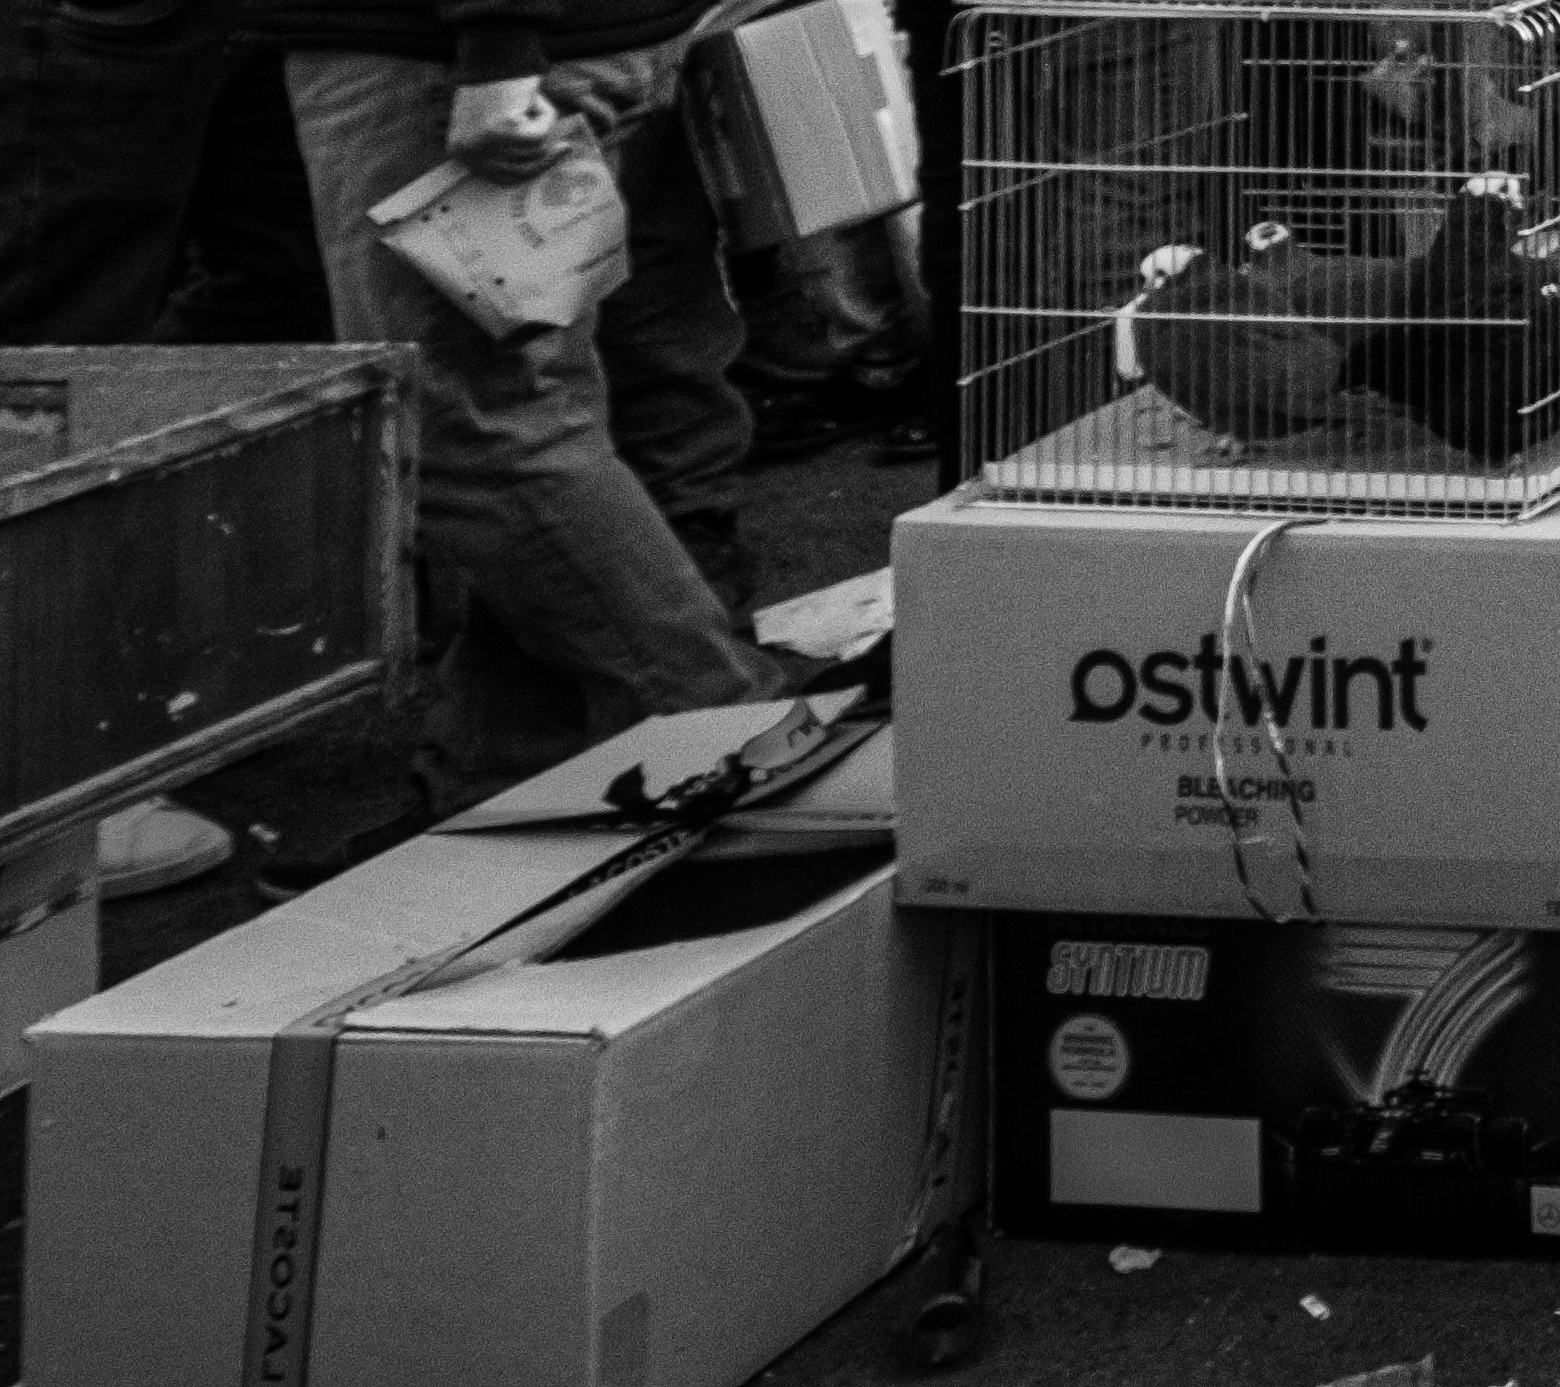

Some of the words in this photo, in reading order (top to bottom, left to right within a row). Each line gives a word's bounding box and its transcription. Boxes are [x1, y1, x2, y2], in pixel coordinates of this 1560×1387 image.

[1068, 632, 1431, 733] ostwint
[1140, 732, 1353, 758] PROFSSONAL
[1177, 774, 1317, 803] BLEACHING
